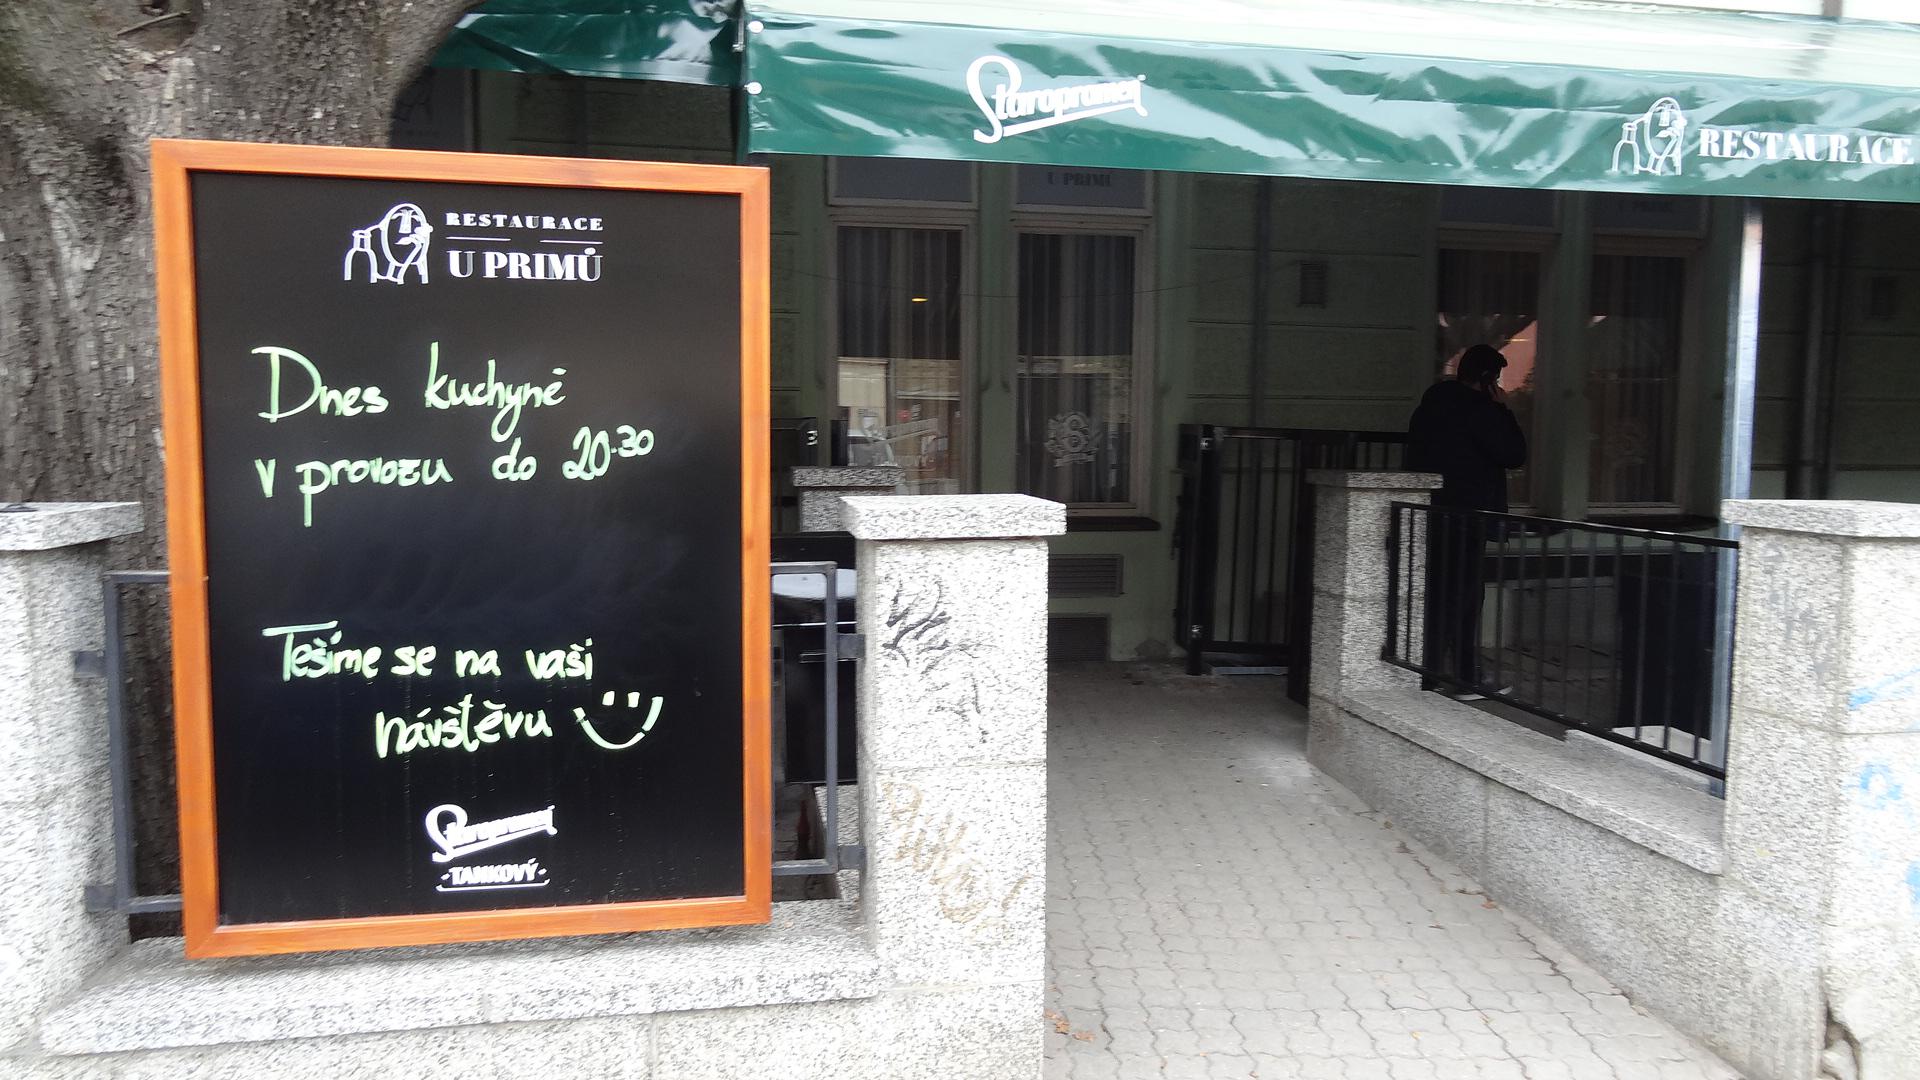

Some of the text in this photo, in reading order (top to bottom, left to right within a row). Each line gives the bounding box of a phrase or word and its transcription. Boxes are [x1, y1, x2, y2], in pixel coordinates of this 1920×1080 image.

[1697, 127, 1915, 165] RESTAURACE
[445, 212, 604, 232] RESTAURACE
[446, 247, 604, 282] U PRIMŮ
[251, 345, 389, 423] Dnes
[296, 457, 453, 528] provozu
[491, 437, 538, 482] do
[391, 644, 437, 677] se
[455, 648, 502, 678] na
[525, 637, 594, 680] vaši
[376, 693, 553, 759] návštěvu
